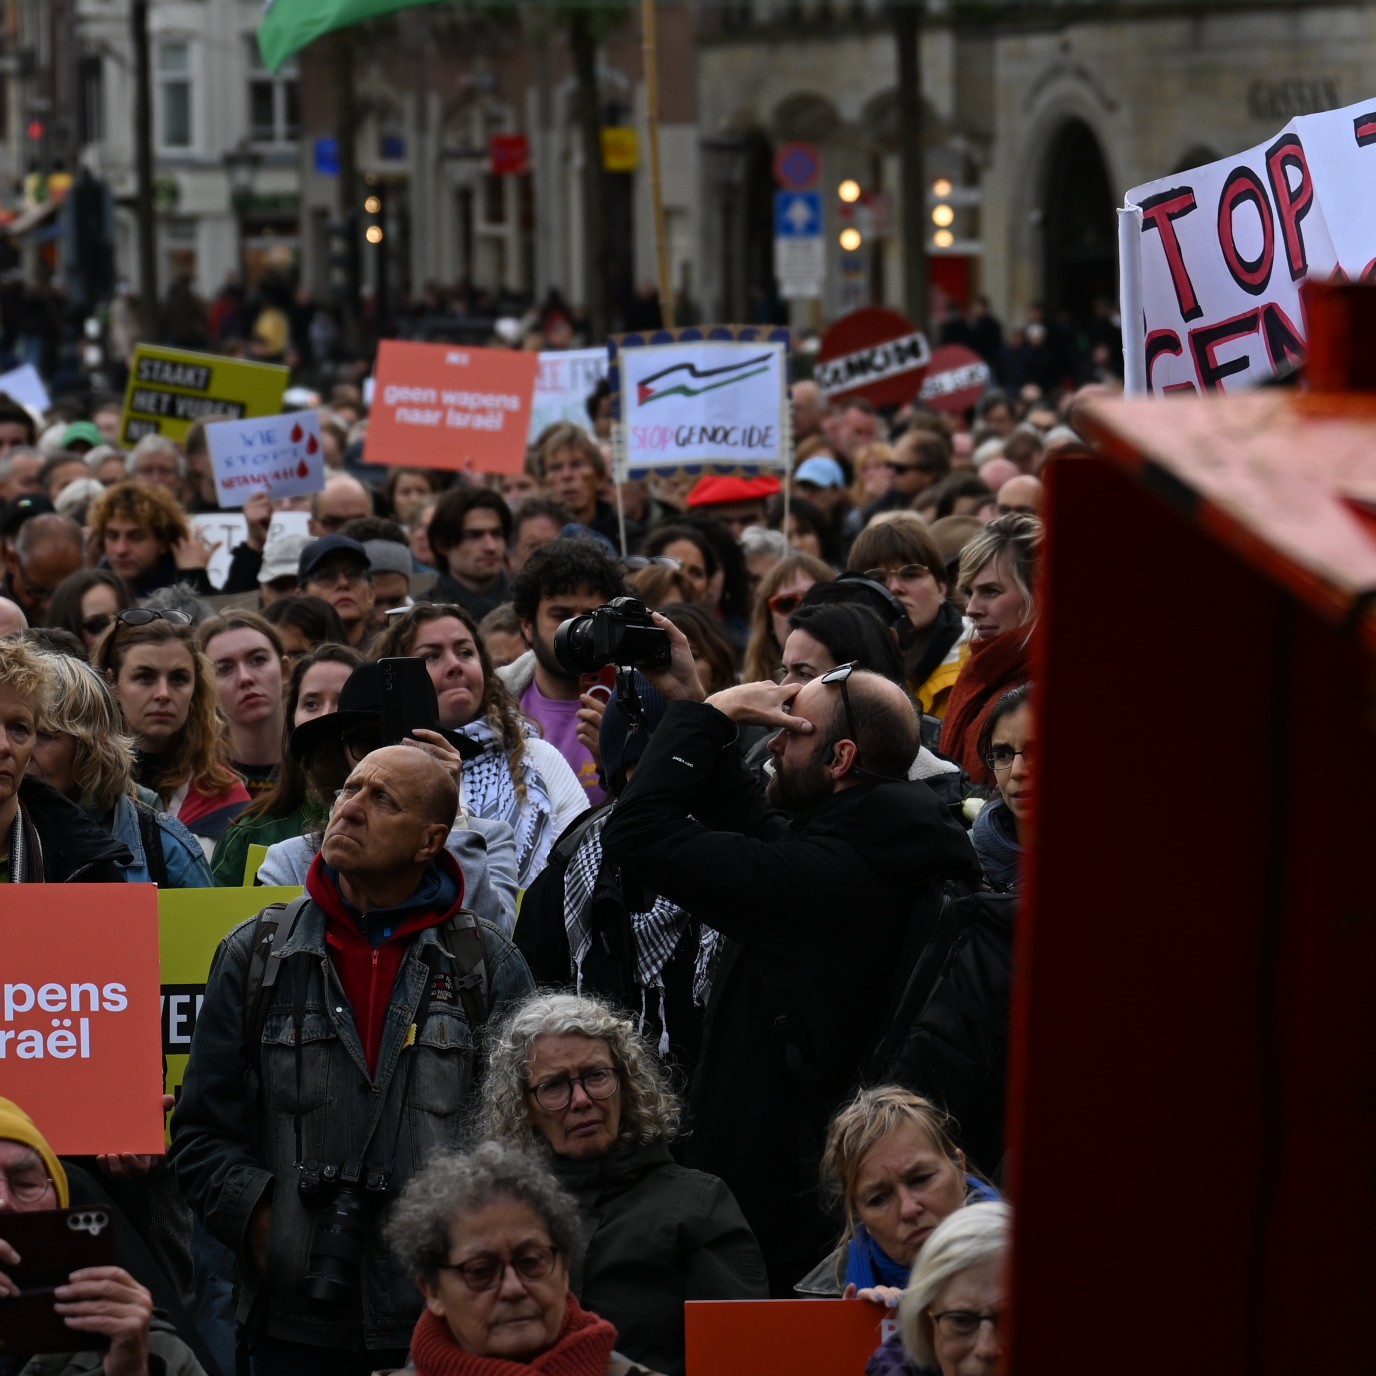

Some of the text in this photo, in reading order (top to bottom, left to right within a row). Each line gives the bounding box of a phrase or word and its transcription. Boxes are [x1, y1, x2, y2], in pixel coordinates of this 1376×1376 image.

[1142, 132, 1313, 323] TOP
[138, 358, 210, 389] STAAKT
[384, 385, 520, 411] geen wapens
[632, 424, 775, 450] STOP GENOCIDE
